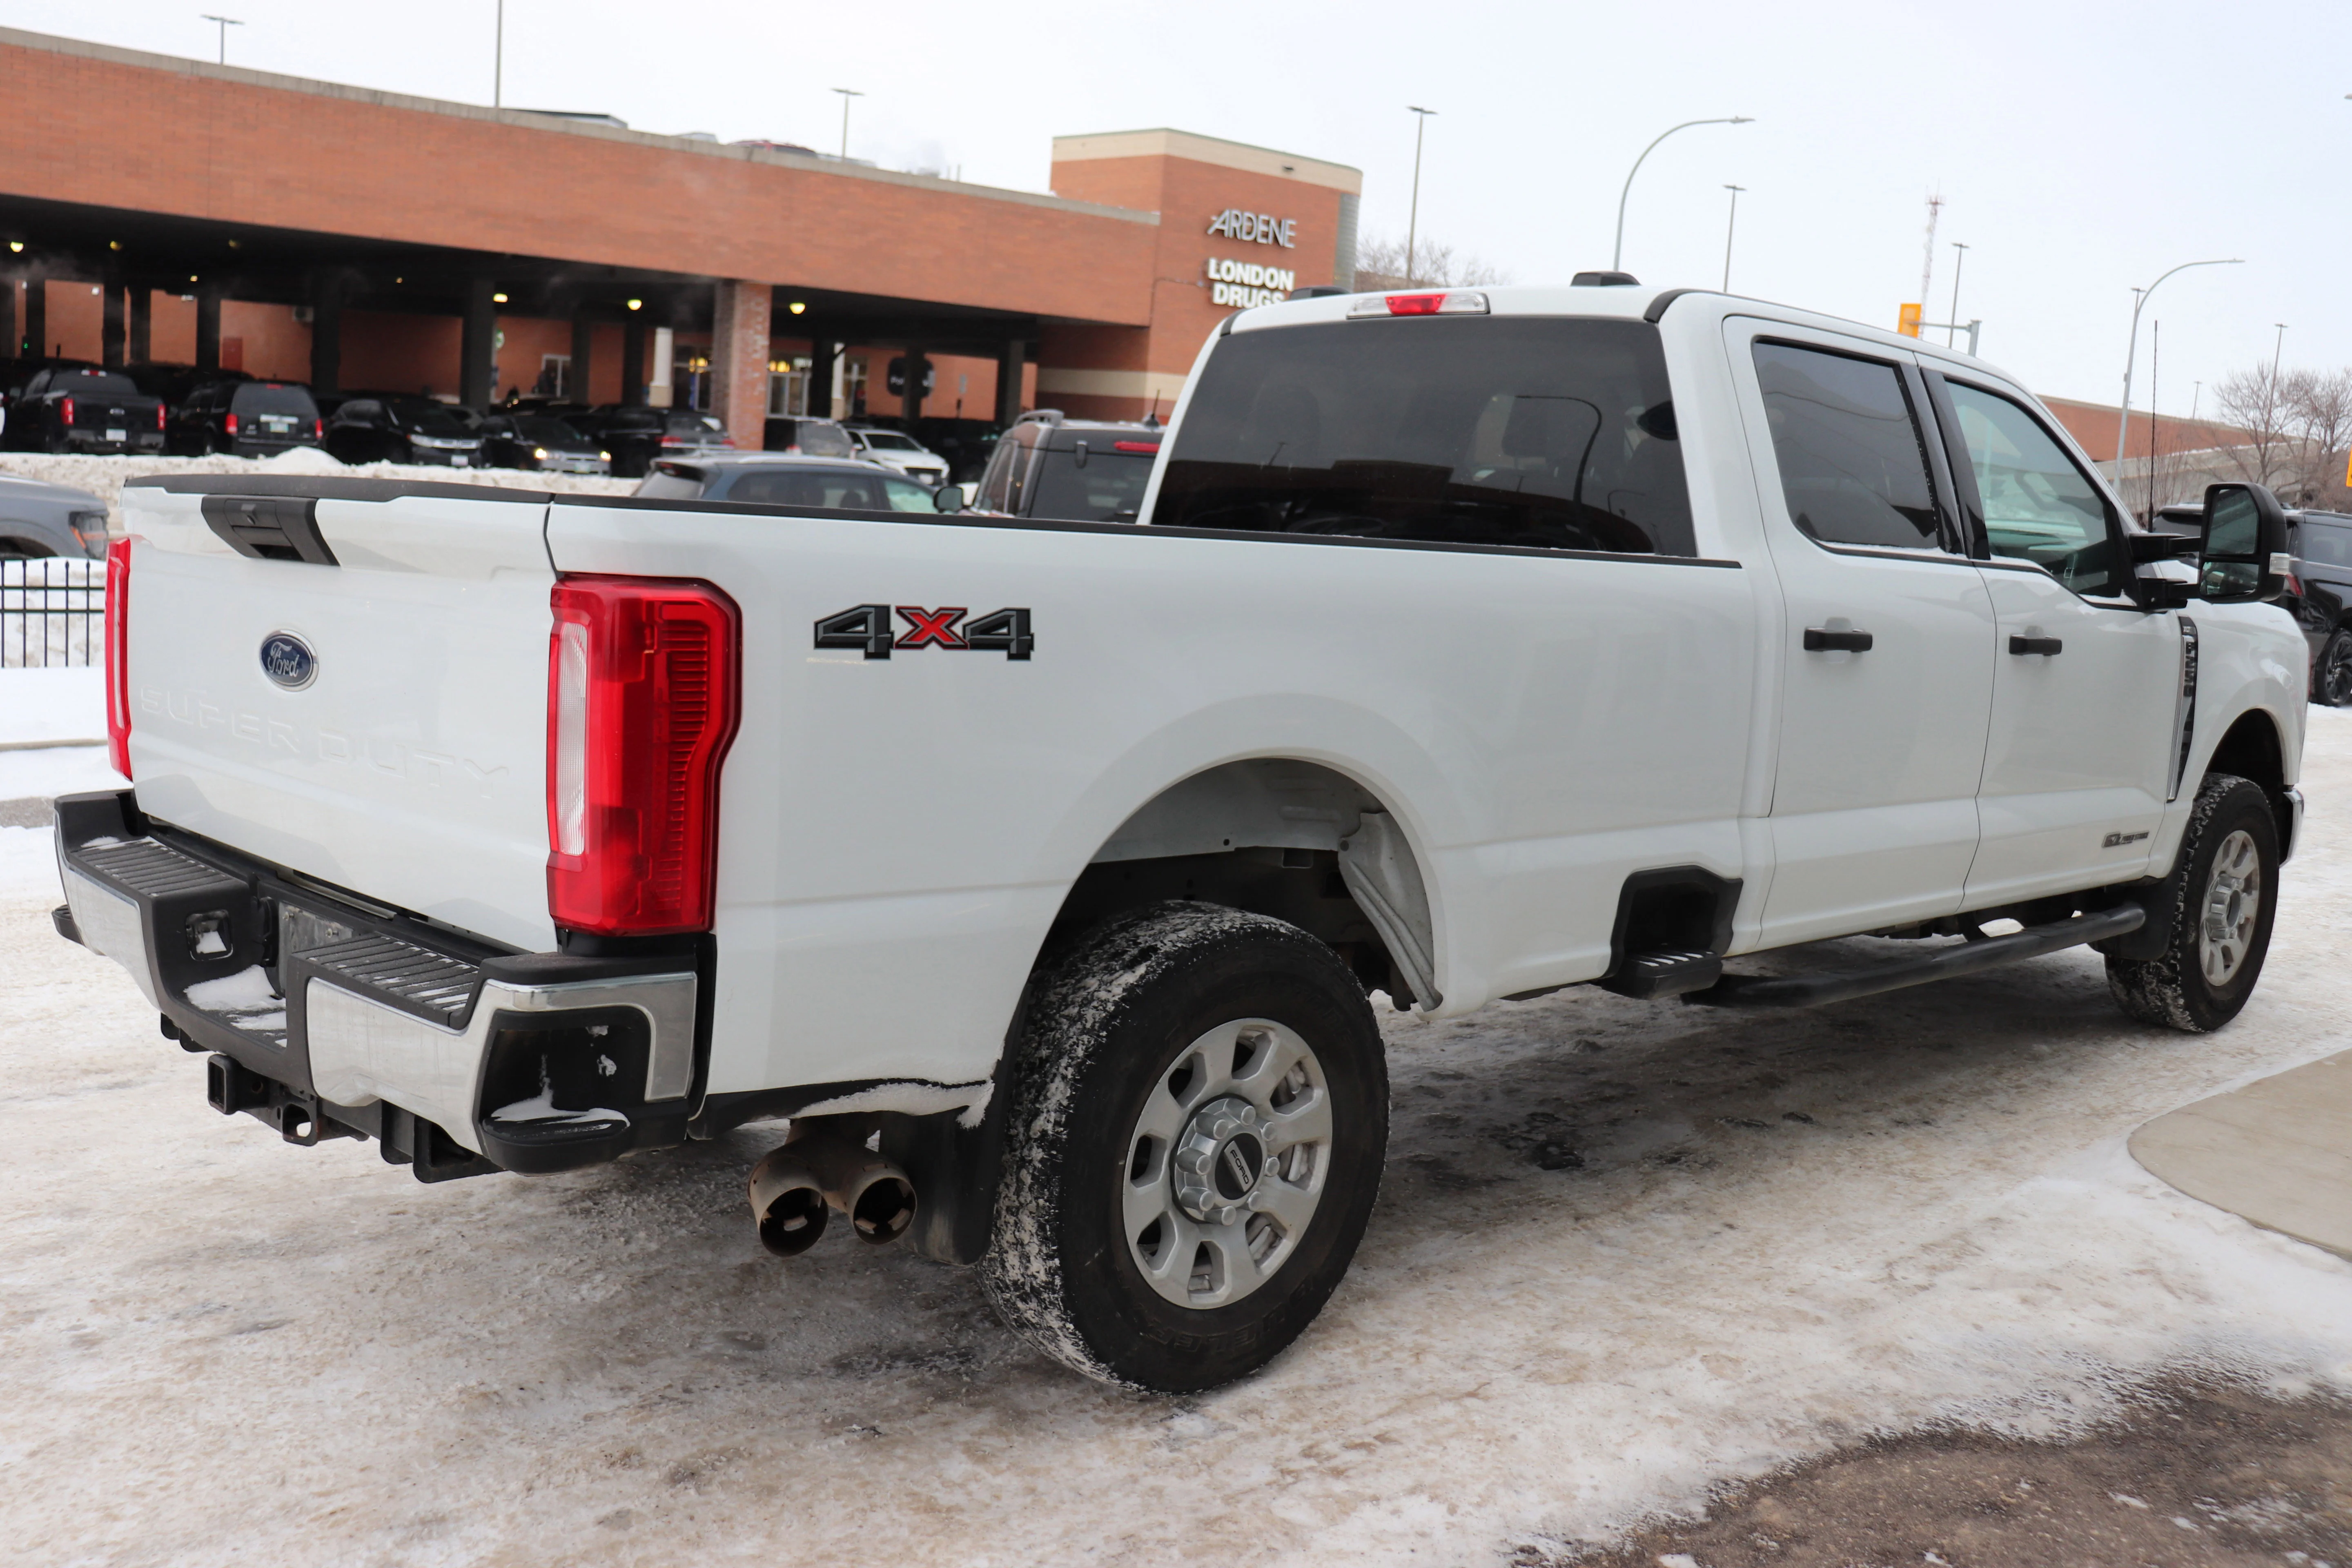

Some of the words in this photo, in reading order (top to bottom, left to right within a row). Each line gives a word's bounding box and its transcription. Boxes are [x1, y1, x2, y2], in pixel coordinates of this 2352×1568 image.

[1207, 209, 1297, 248] ARDENE
[1208, 257, 1294, 292] LONDON
[1212, 282, 1286, 308] DRUGS
[267, 641, 300, 678] Ford
[318, 726, 510, 799] DUTY
[1230, 1149, 1250, 1185] FORD
